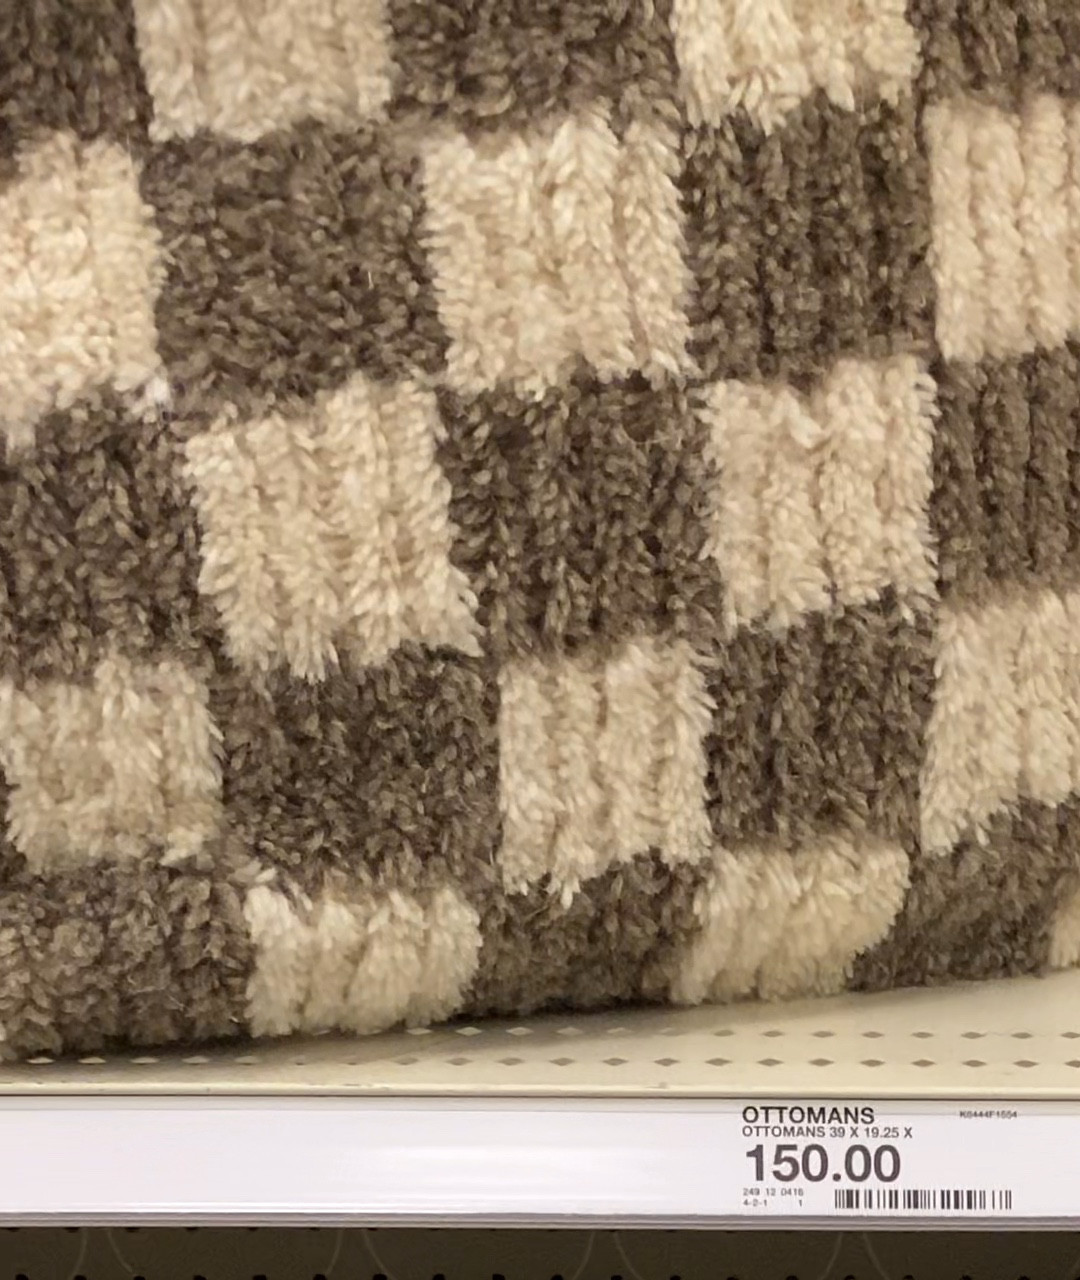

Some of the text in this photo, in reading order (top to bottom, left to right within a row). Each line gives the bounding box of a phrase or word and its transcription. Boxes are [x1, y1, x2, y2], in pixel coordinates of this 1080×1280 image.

[742, 1106, 875, 1124] OTTOMANS
[742, 1125, 913, 1138] OTTOMANS 39 X 19.25 X
[746, 1143, 901, 1182] 150.00
